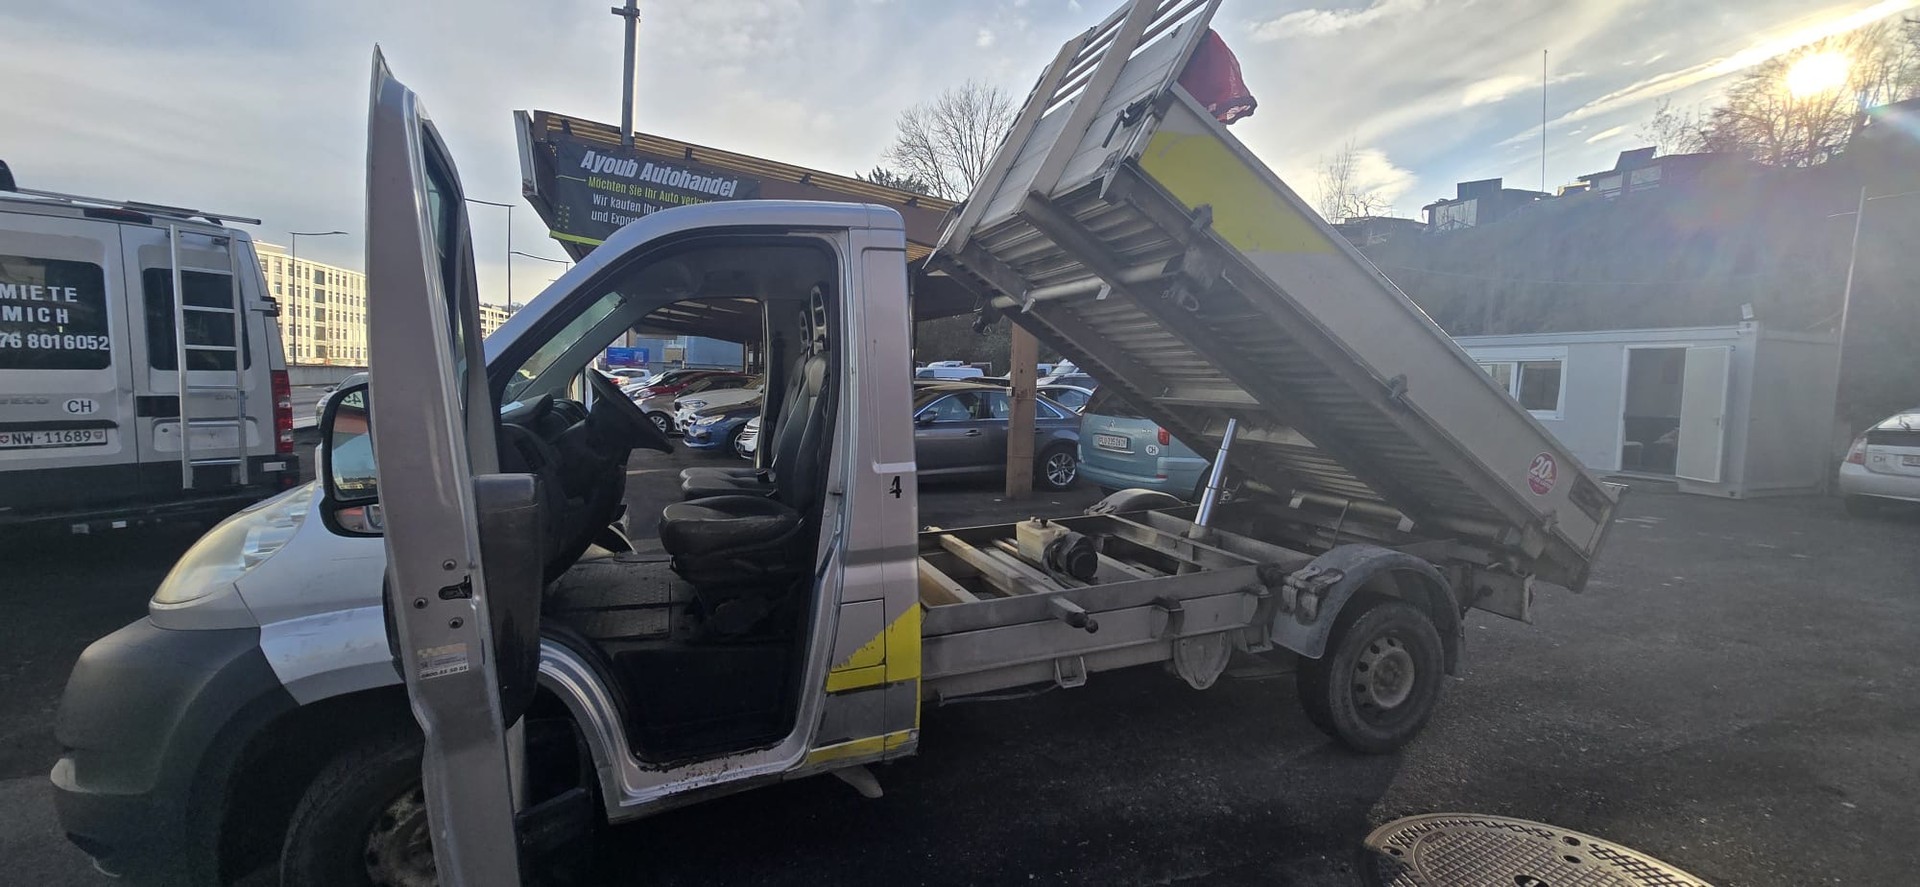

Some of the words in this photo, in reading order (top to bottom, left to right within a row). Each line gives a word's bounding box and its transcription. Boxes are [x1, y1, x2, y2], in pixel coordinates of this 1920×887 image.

[580, 150, 639, 178] Ayoub
[639, 162, 738, 198] Autohandel
[592, 193, 609, 206] Wir
[610, 196, 641, 213] kaufen
[629, 183, 642, 197] Sie
[645, 187, 657, 200] Ihr
[659, 190, 679, 204] Auto
[591, 210, 609, 223] und
[0, 283, 78, 303] MIETE
[2, 305, 69, 324] MICH
[67, 400, 92, 413] CH
[1530, 456, 1552, 479] 20
[889, 475, 902, 499] 4
